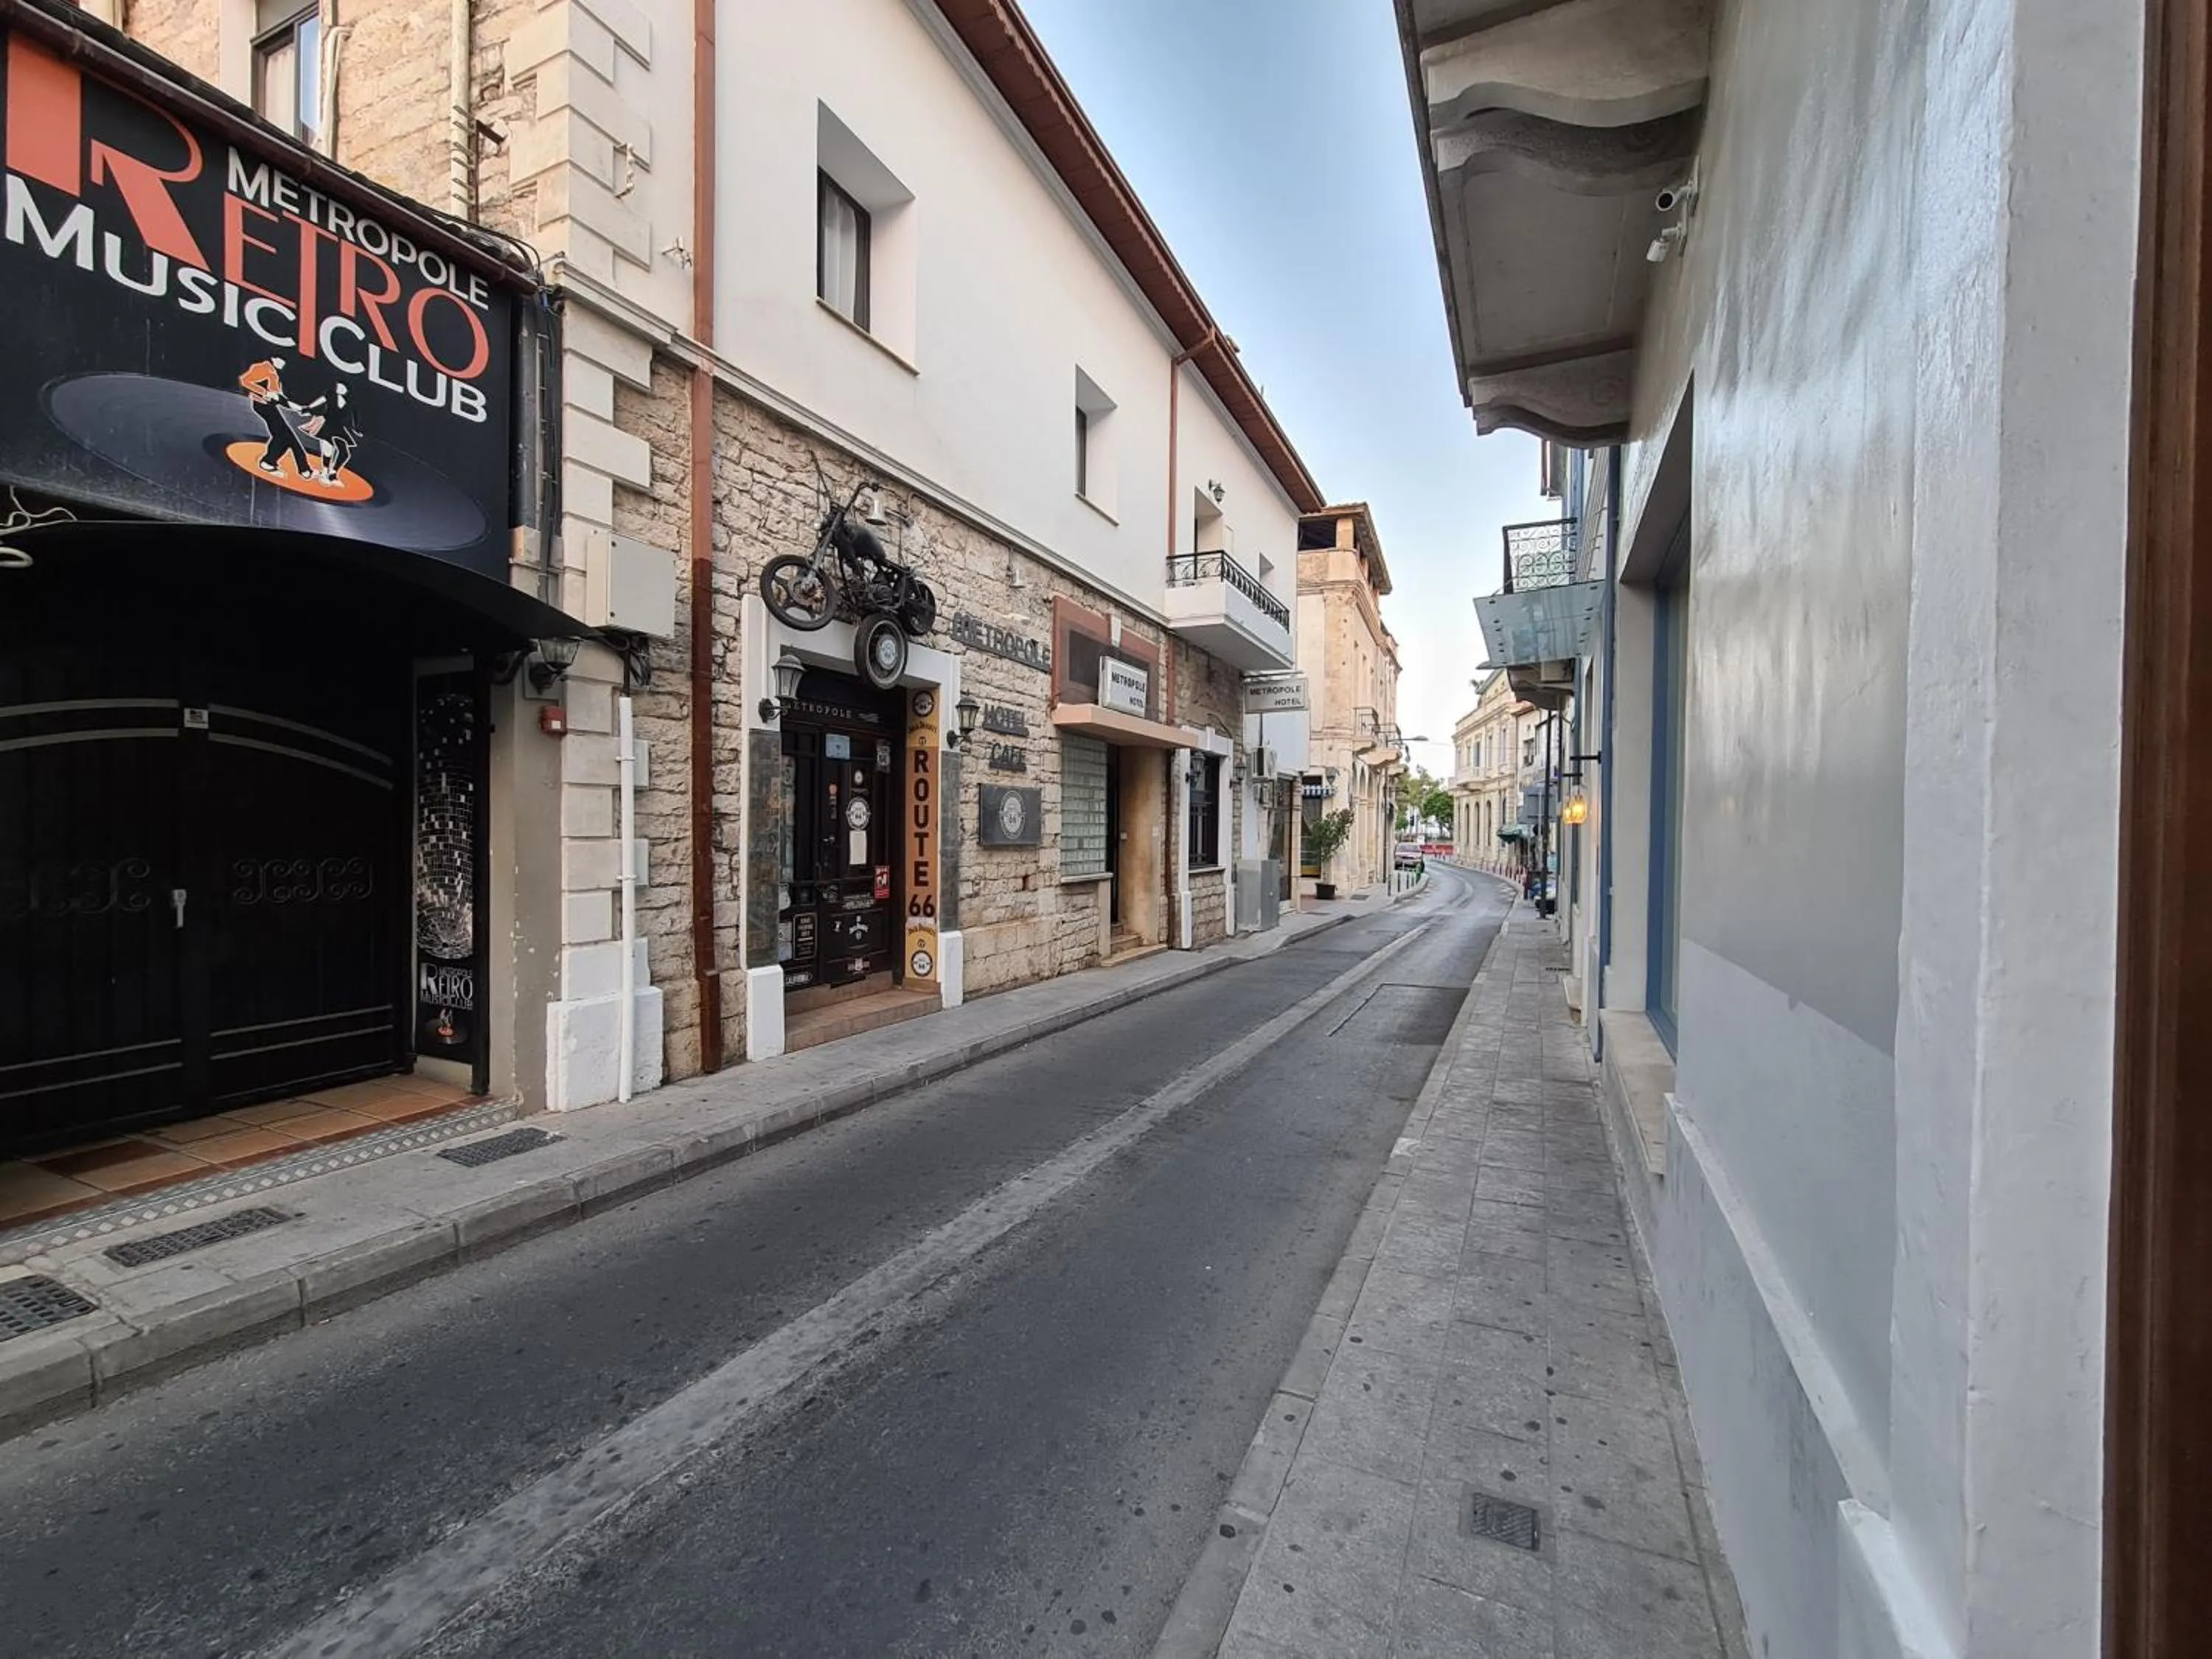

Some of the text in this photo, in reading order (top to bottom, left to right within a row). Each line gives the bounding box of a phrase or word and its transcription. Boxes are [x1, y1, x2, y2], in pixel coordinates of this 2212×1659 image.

[6, 29, 490, 380] RETRO
[227, 147, 489, 310] METROPOLE
[6, 174, 487, 422] MUSIC CLUB
[984, 703, 1028, 733] HOTEL
[1250, 685, 1301, 695] METROPOLE
[1274, 698, 1301, 706] HOTEL
[914, 750, 929, 887] ROUTE
[908, 894, 936, 918] 66
